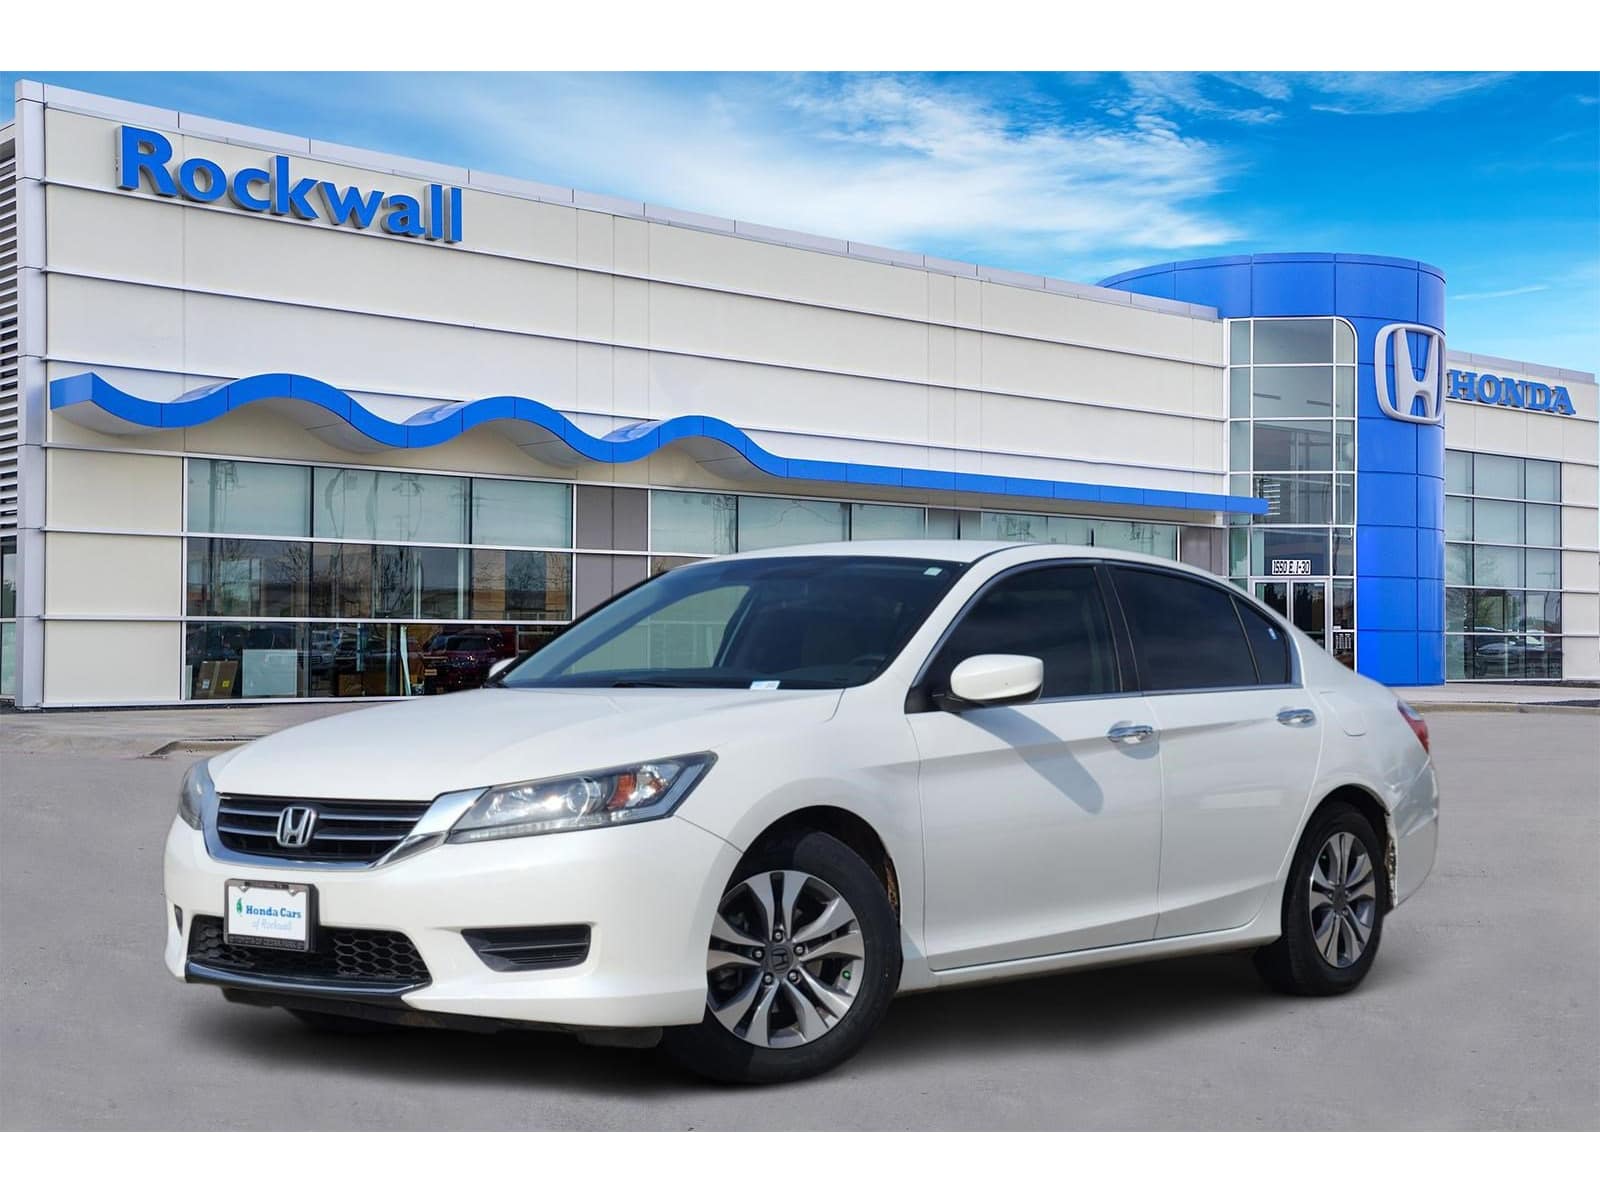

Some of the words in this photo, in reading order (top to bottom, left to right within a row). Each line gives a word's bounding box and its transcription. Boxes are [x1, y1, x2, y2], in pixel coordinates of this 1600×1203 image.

[117, 125, 463, 243] Rockwall
[1446, 369, 1576, 415] HONDA
[1273, 560, 1287, 574] 1550
[246, 905, 279, 917] Honda
[280, 907, 302, 919] Cars
